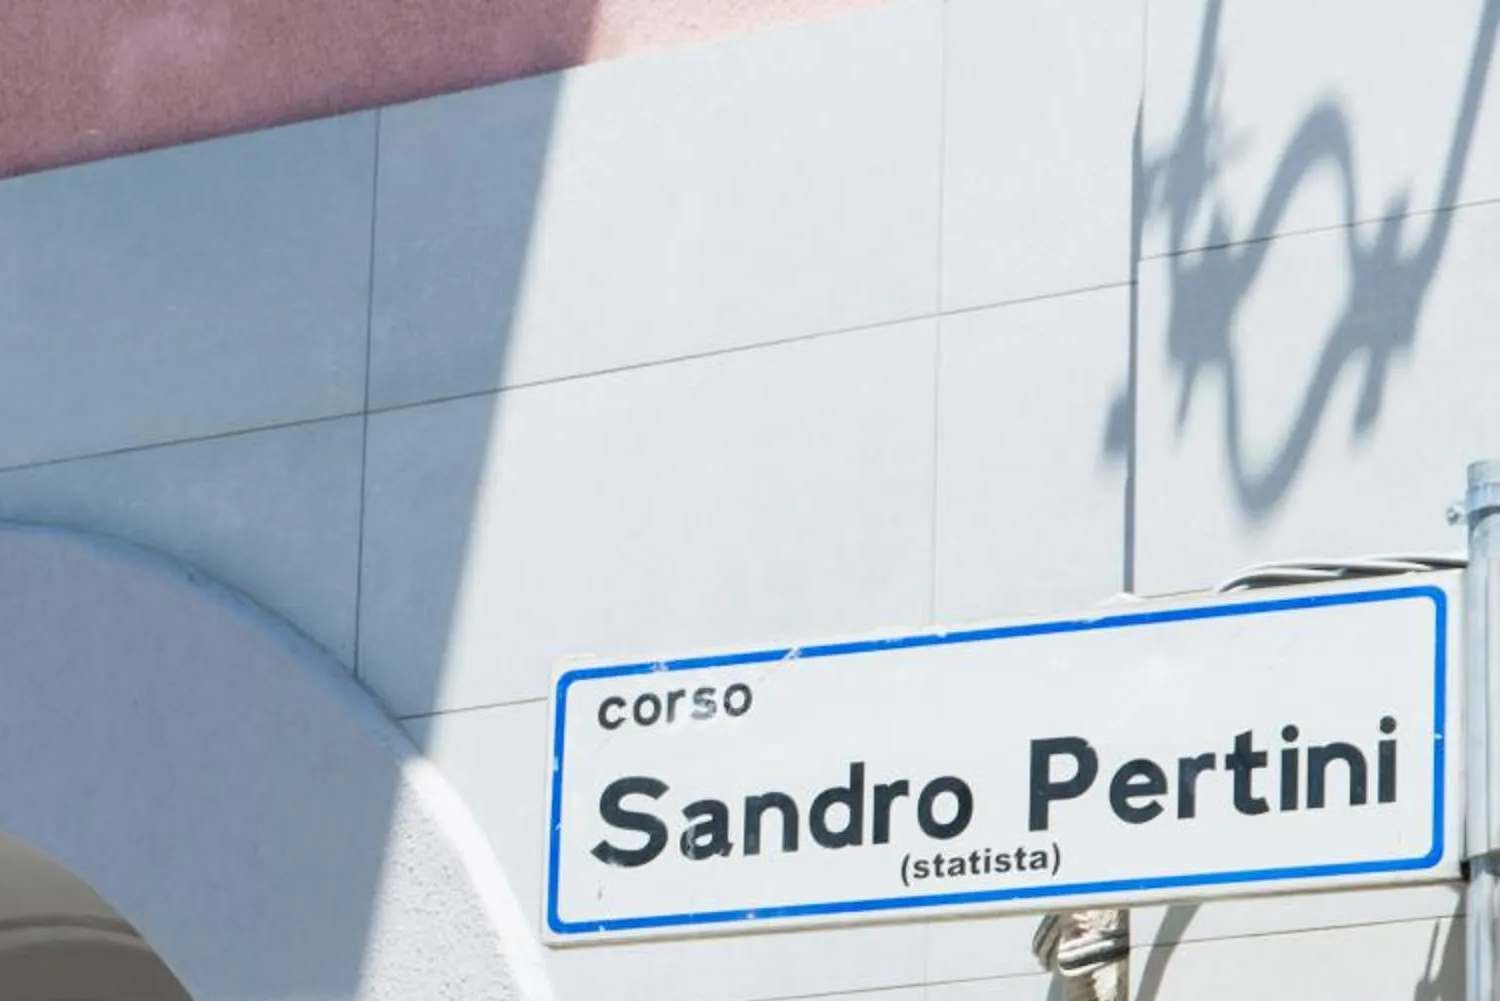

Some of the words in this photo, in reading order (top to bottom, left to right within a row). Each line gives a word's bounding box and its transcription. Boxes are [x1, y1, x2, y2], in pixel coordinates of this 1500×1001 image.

[596, 681, 754, 731] corso
[590, 762, 975, 869] Sandro
[1029, 715, 1398, 833] Pertini
[900, 842, 1063, 886] (statista)
